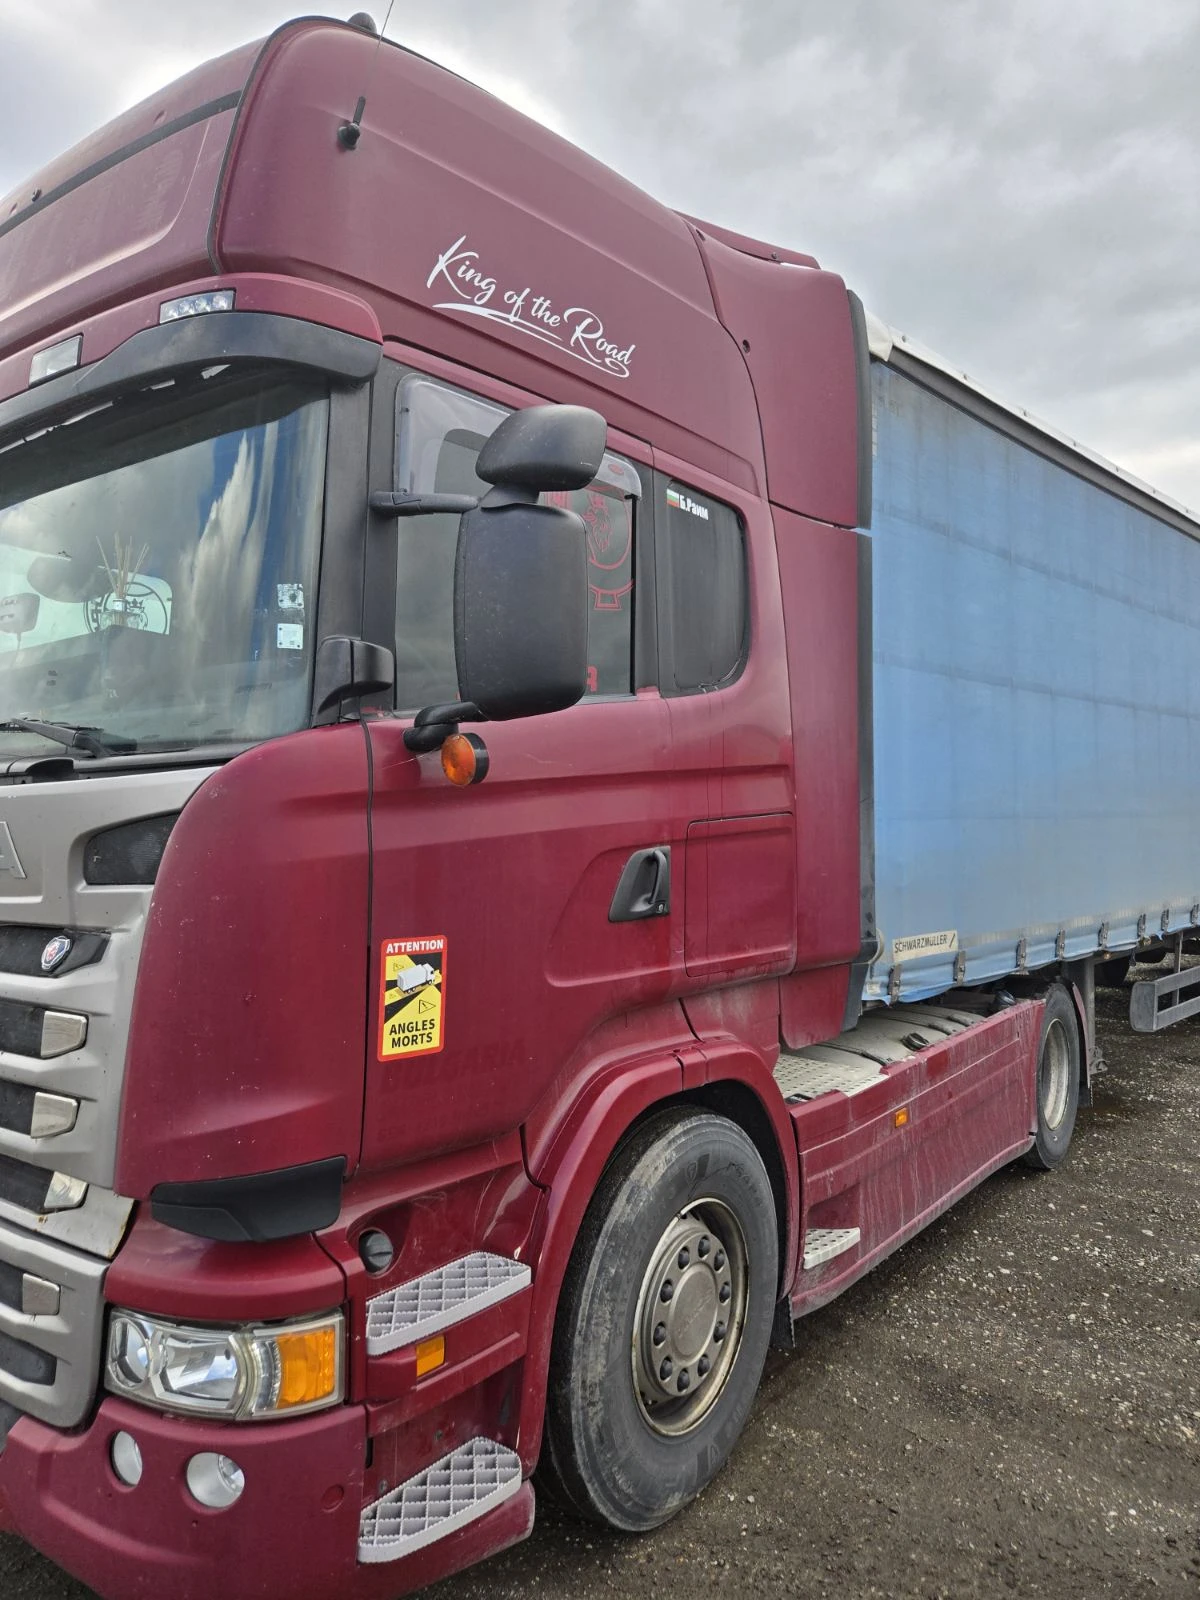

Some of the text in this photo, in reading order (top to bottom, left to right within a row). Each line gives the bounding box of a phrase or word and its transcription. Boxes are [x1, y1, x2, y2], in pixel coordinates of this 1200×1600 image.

[426, 234, 636, 365] King of the Road
[386, 939, 444, 954] ATTENTION
[389, 1018, 435, 1036] ANGLES
[391, 1032, 433, 1049] MORTS
